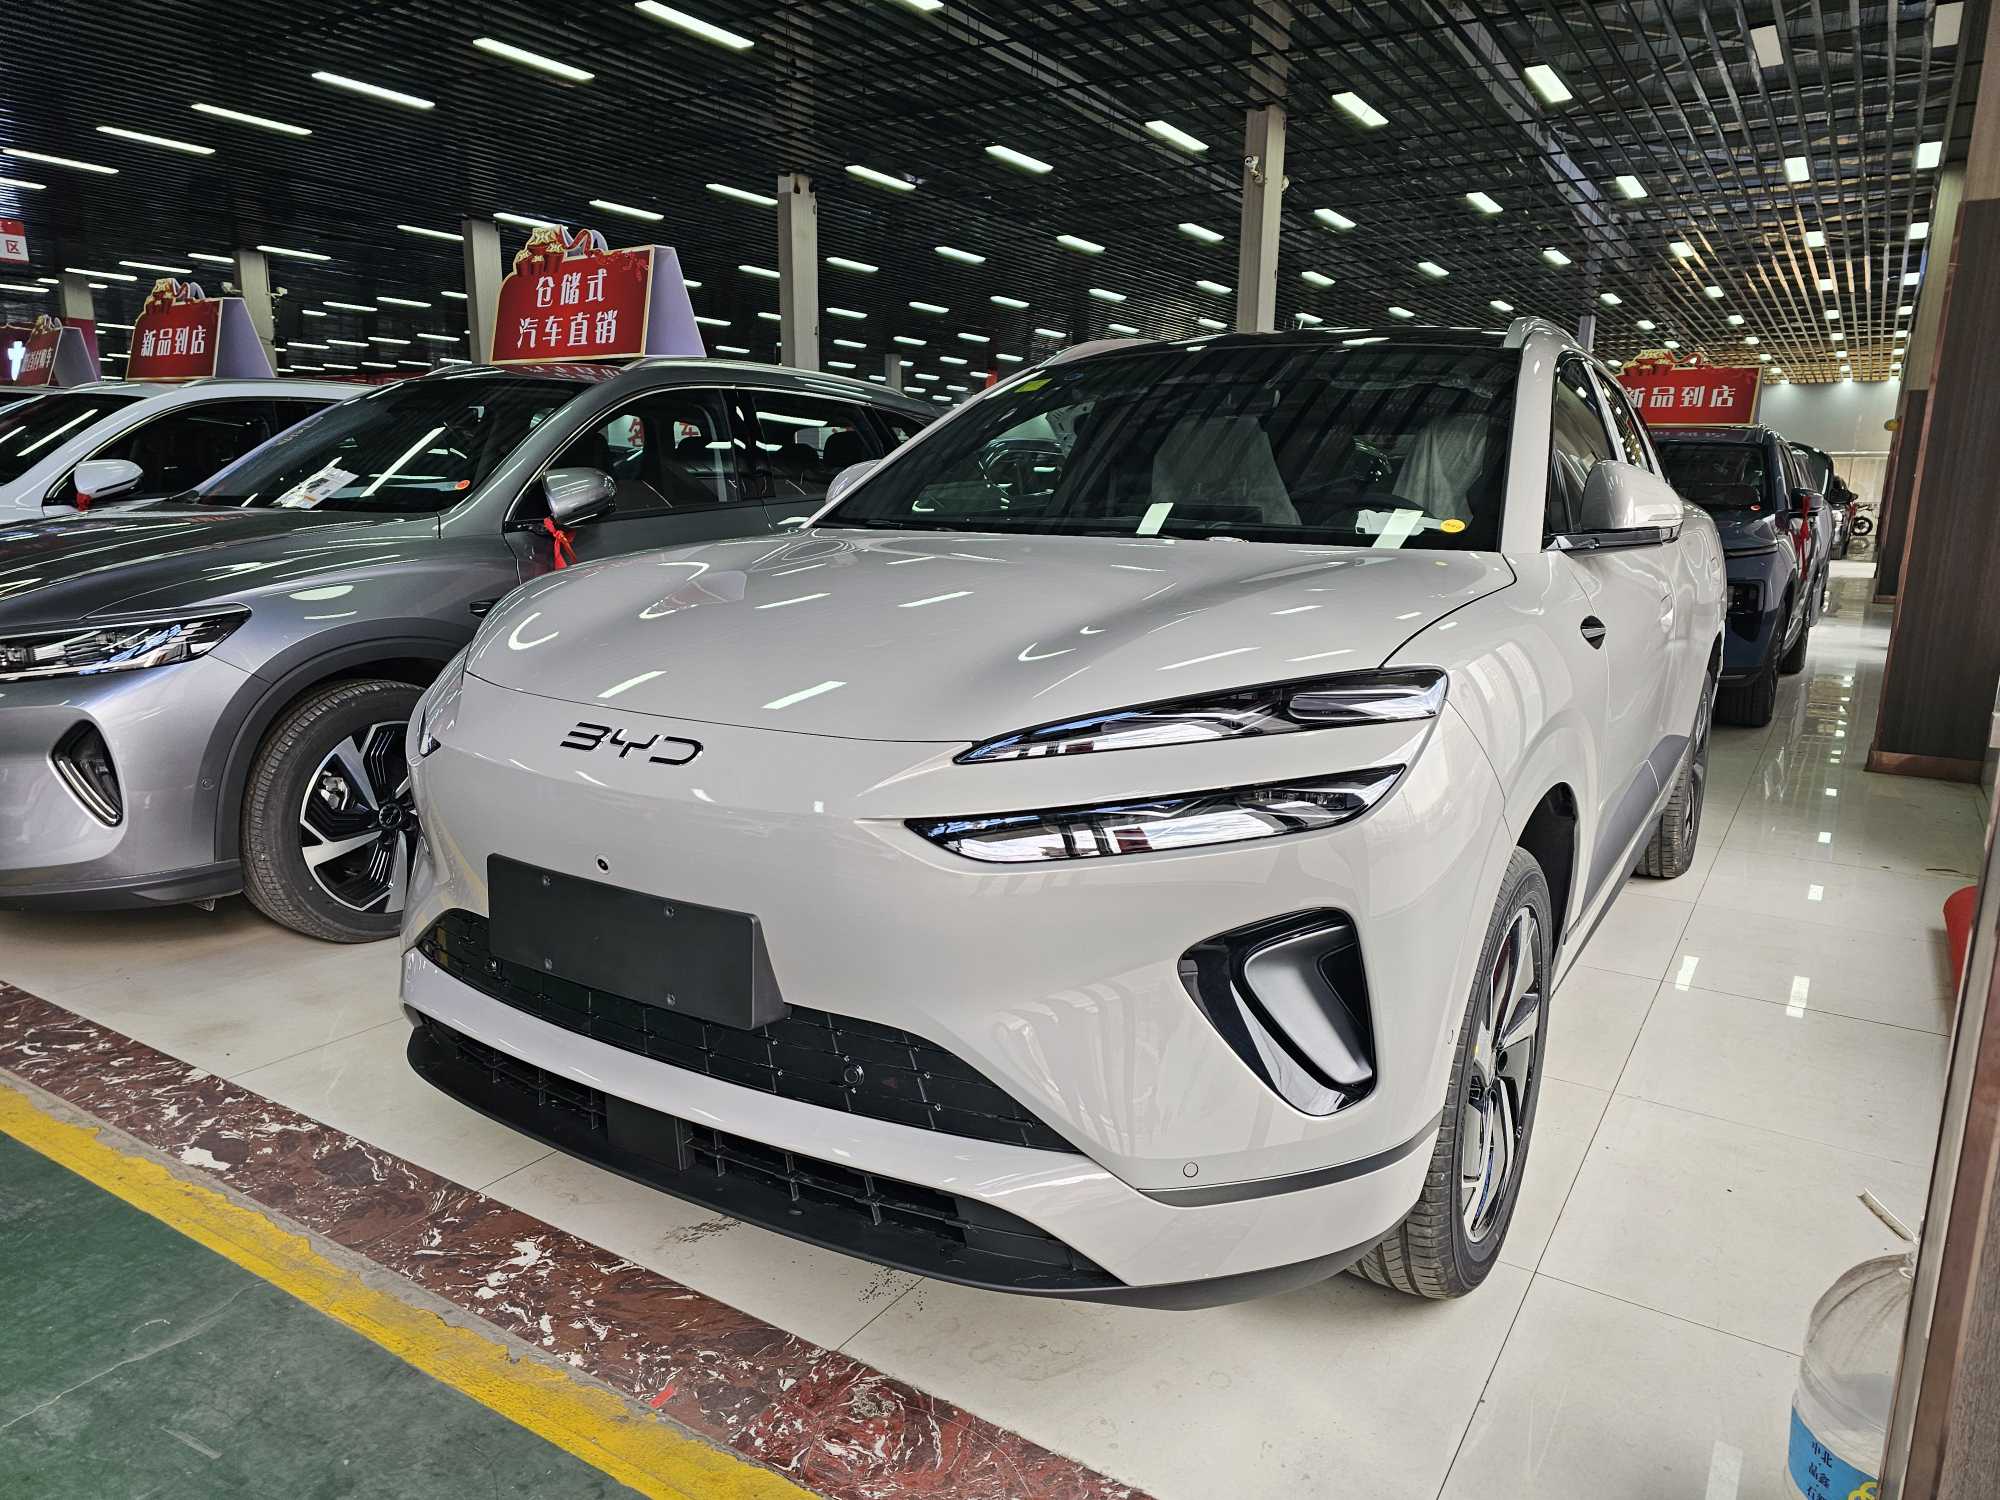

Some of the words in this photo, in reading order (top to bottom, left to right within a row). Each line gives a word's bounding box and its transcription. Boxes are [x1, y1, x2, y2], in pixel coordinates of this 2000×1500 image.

[5, 240, 21, 254] 区
[536, 268, 608, 307] 仓储式
[141, 325, 207, 357] 新品到店
[517, 309, 617, 349] 汽车直销
[560, 721, 704, 766] BYD
